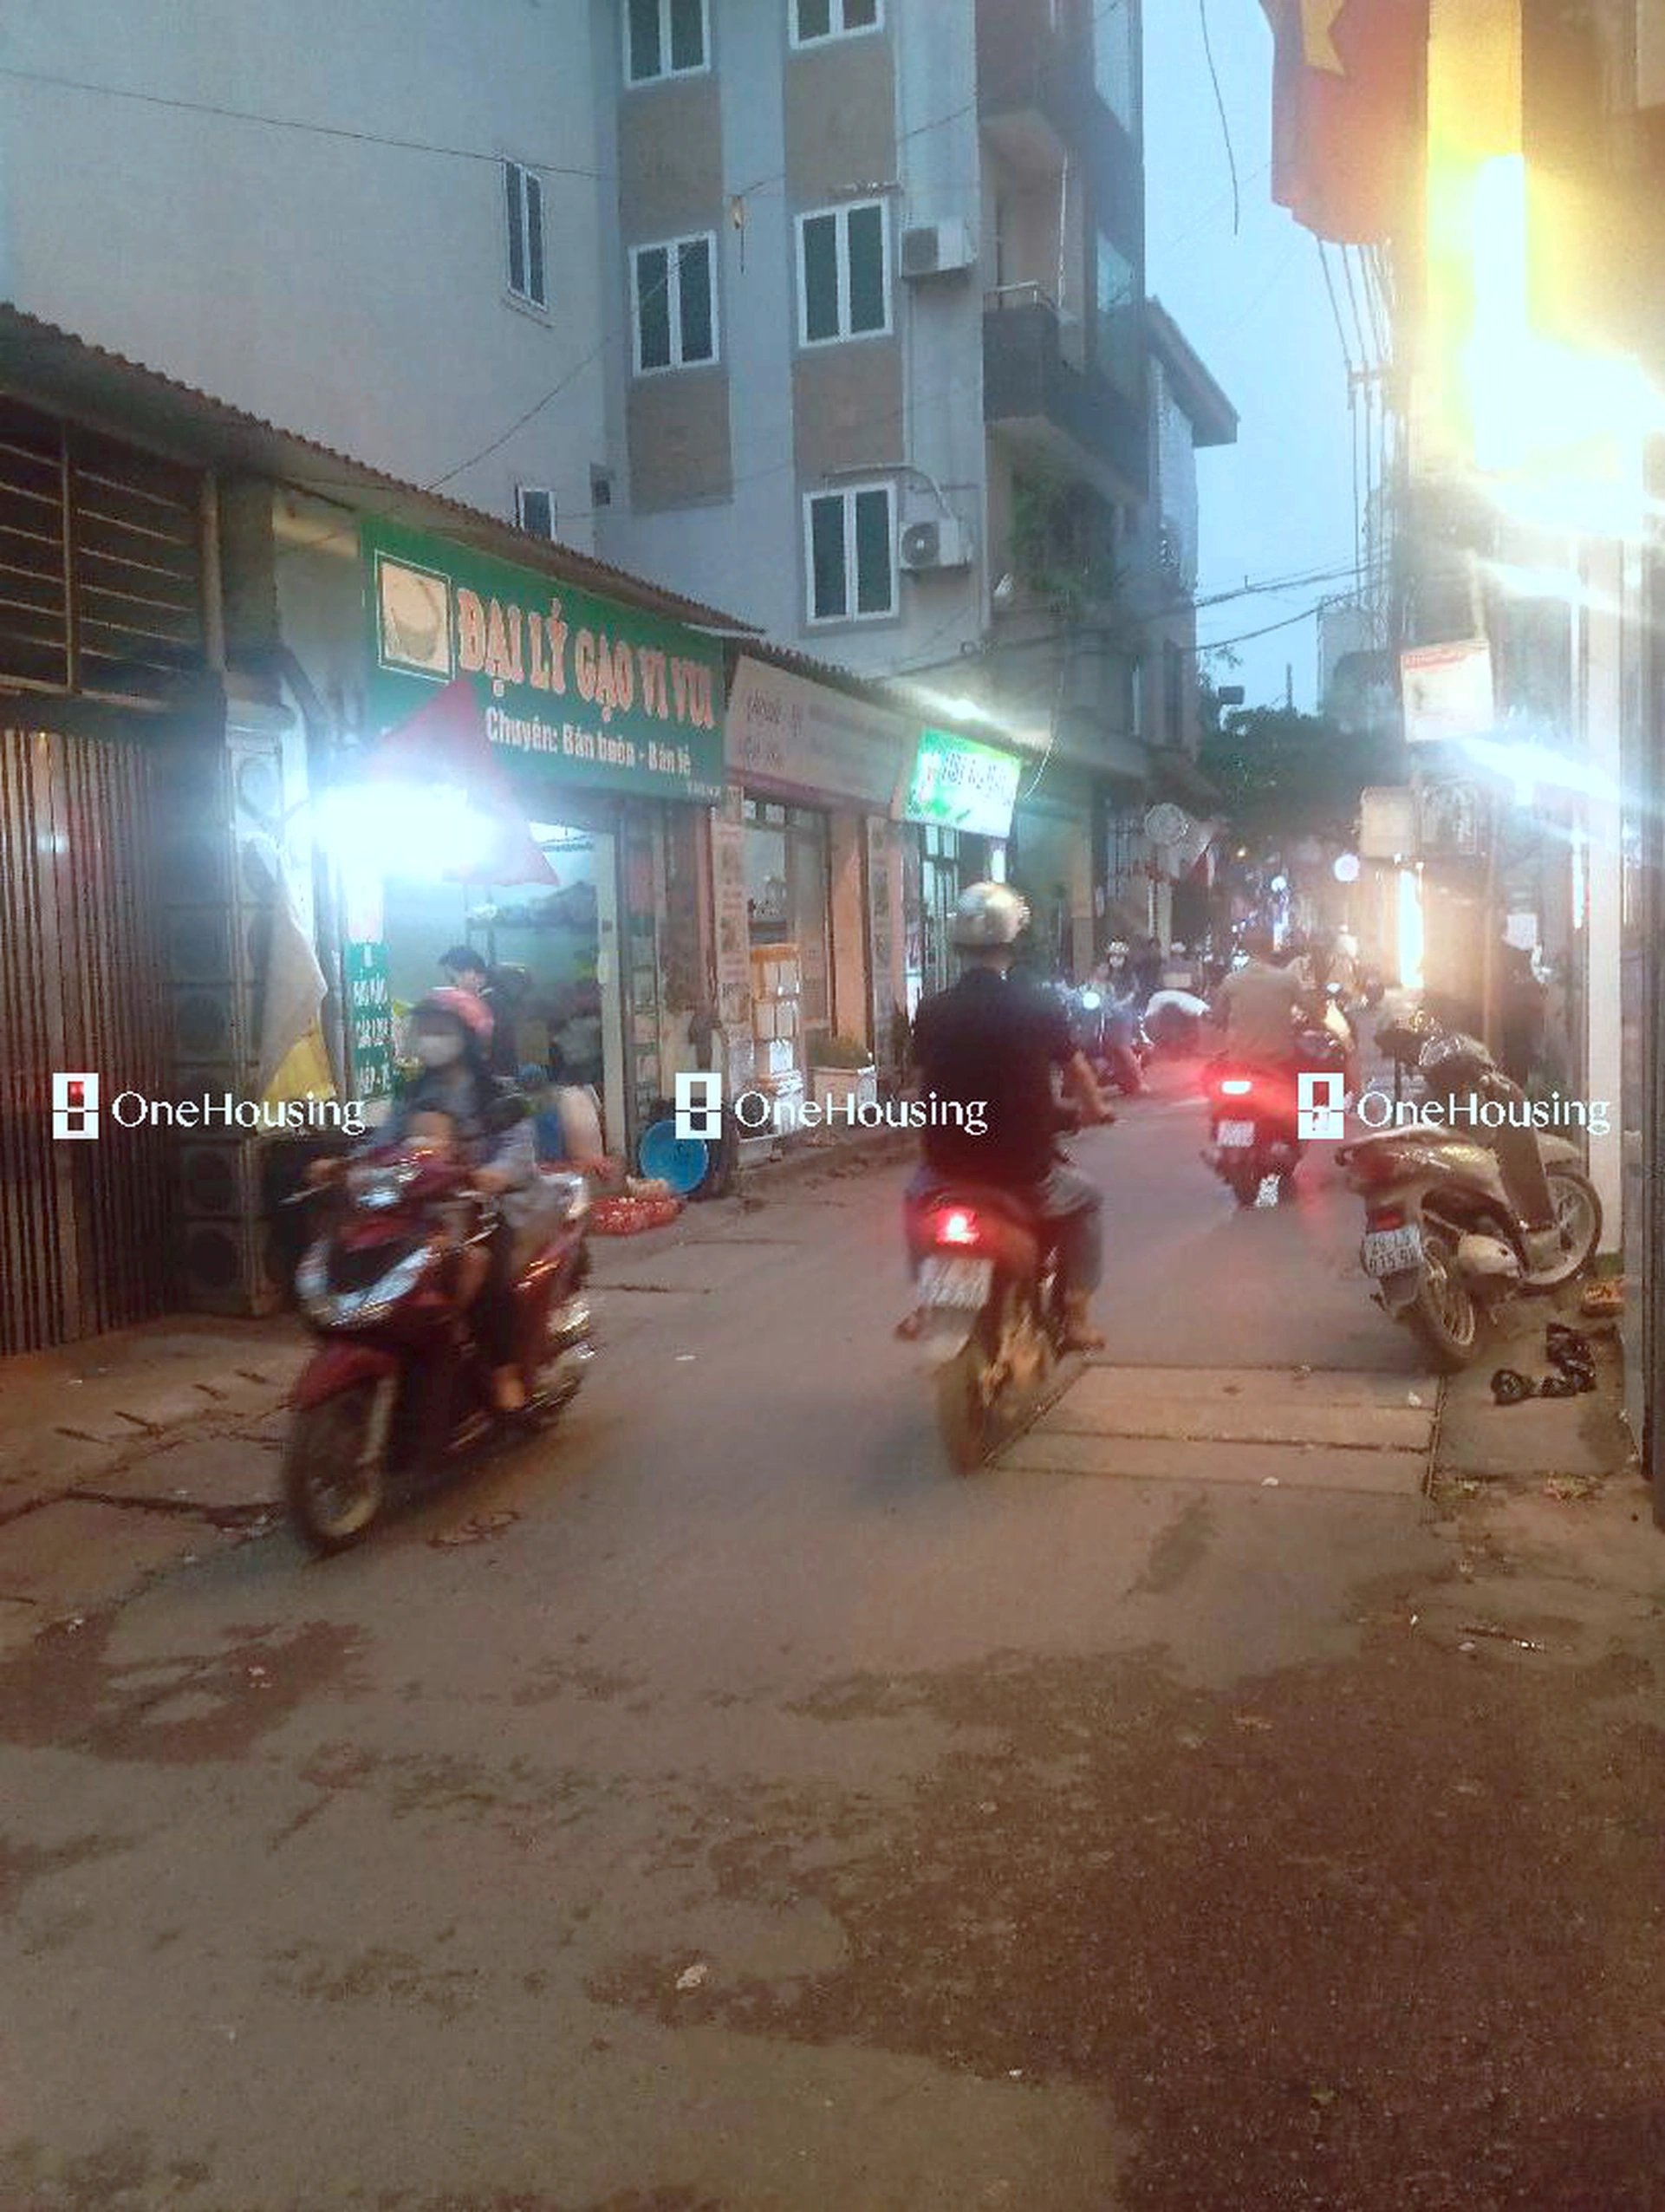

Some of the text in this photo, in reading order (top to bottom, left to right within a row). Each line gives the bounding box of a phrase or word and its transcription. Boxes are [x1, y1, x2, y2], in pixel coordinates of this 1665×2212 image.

[458, 588, 524, 697] ĐẠI
[528, 598, 568, 694] LÝ
[576, 628, 634, 721] GẠO
[563, 723, 595, 759] Bán
